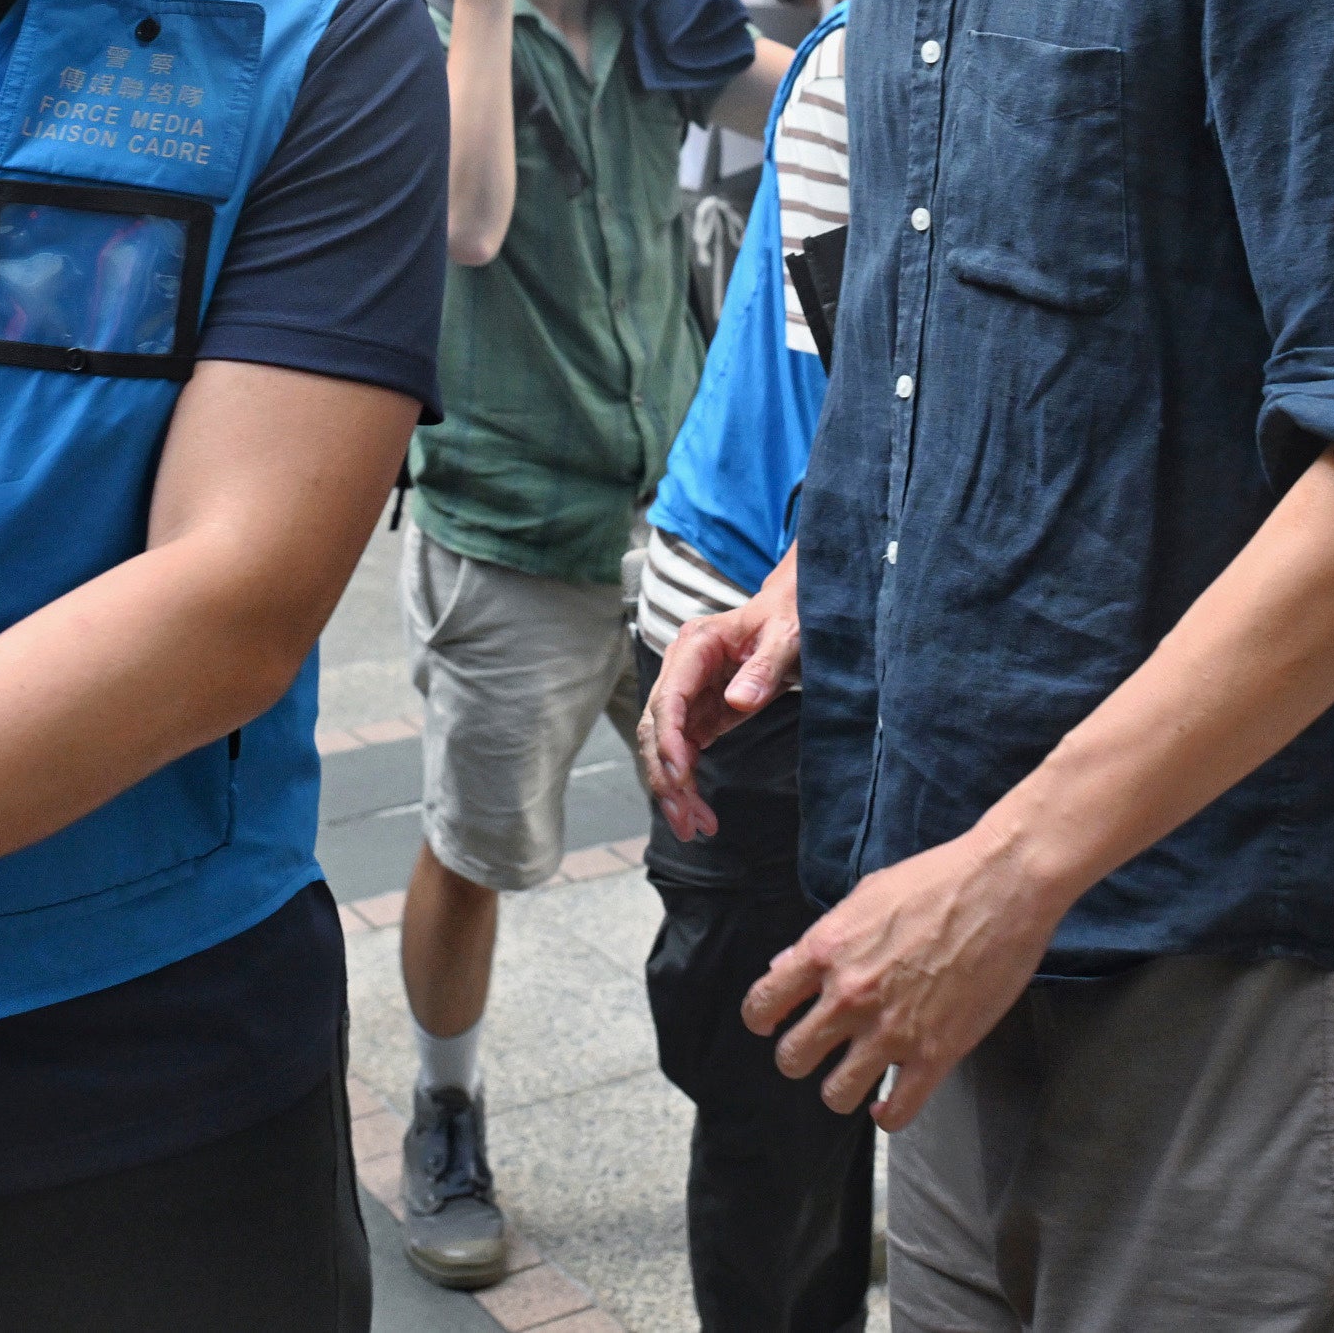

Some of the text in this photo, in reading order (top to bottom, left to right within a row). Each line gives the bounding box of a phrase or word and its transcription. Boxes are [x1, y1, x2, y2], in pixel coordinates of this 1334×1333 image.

[59, 66, 205, 107] 傳媒聯絡隊
[39, 95, 204, 137] FORCE MEDIA
[22, 117, 211, 165] LIAISON CADRE
